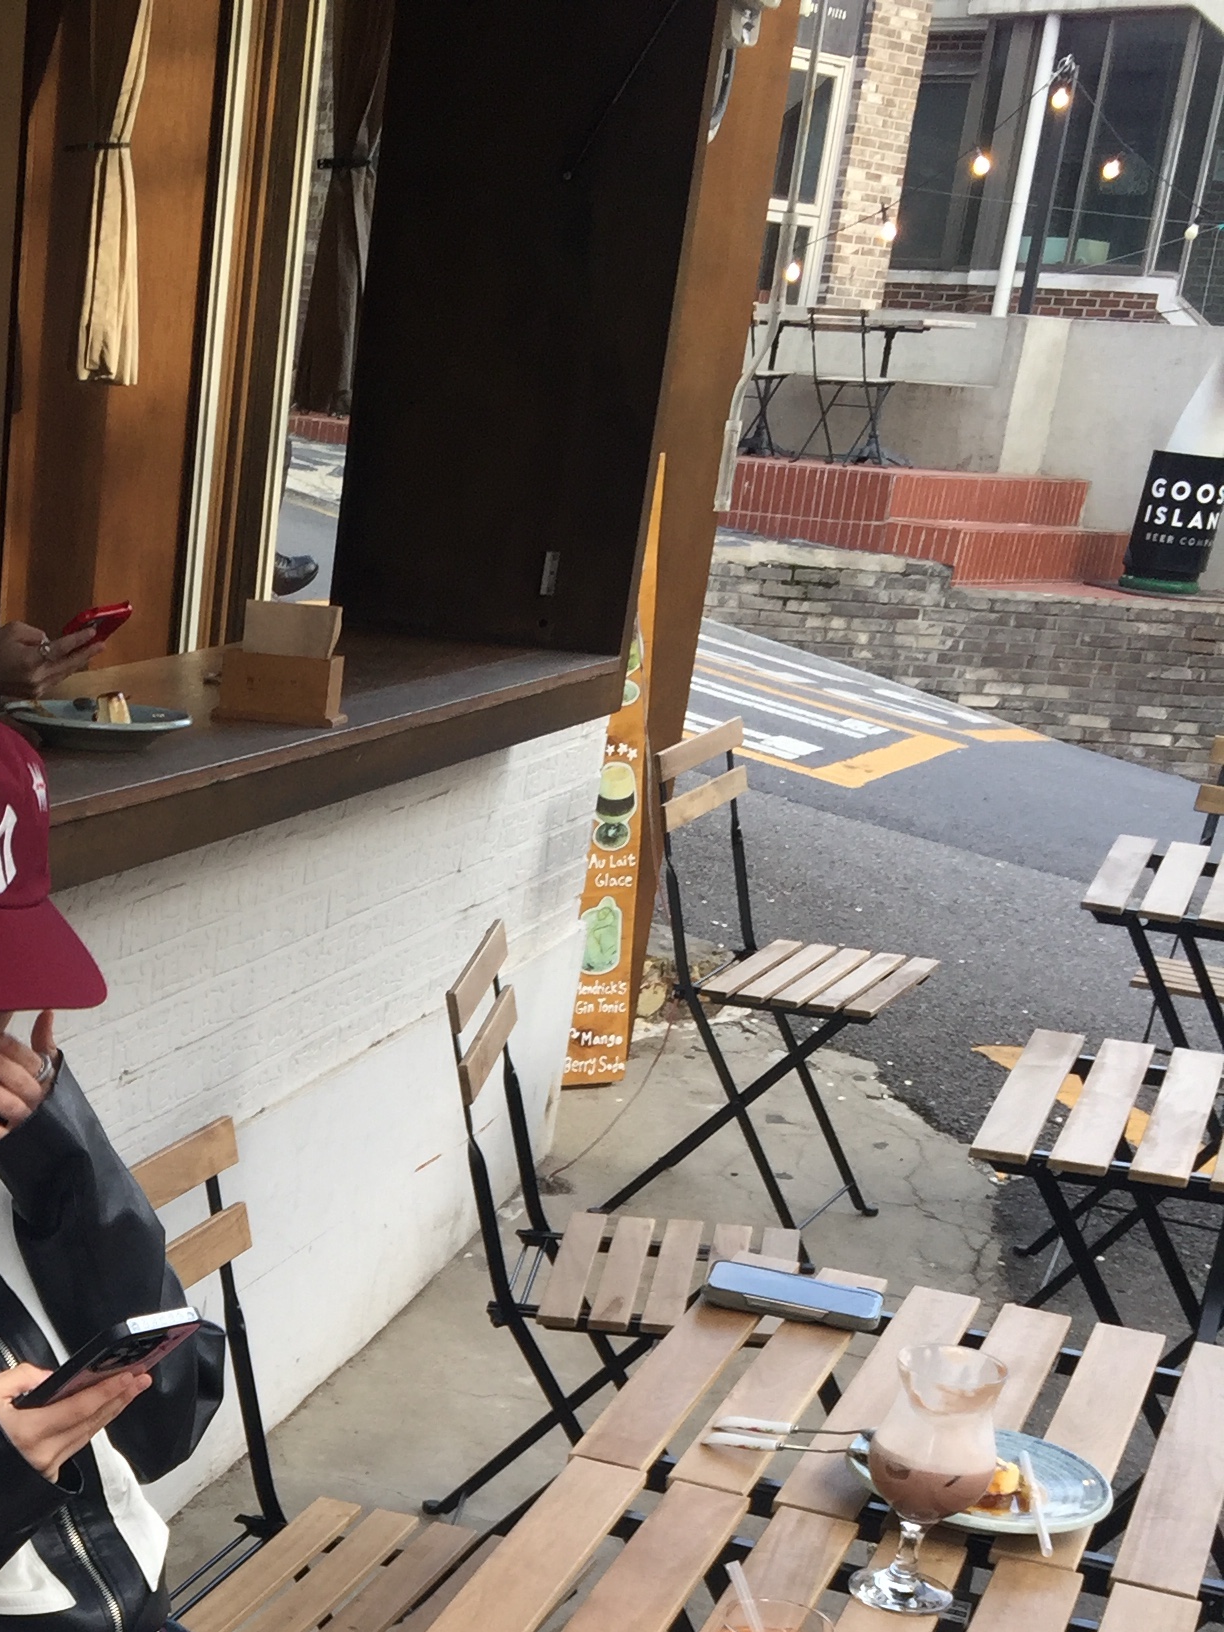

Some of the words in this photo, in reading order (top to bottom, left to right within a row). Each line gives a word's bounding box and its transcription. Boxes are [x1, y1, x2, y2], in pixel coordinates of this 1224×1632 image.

[1145, 532, 1175, 544] BEER
[587, 853, 606, 869] Au
[609, 853, 636, 868] Lait
[594, 872, 633, 887] Glace
[575, 1000, 594, 1014] Gin
[597, 997, 626, 1013] Tonic
[580, 1030, 623, 1048] Mango
[597, 1055, 625, 1074] Soda
